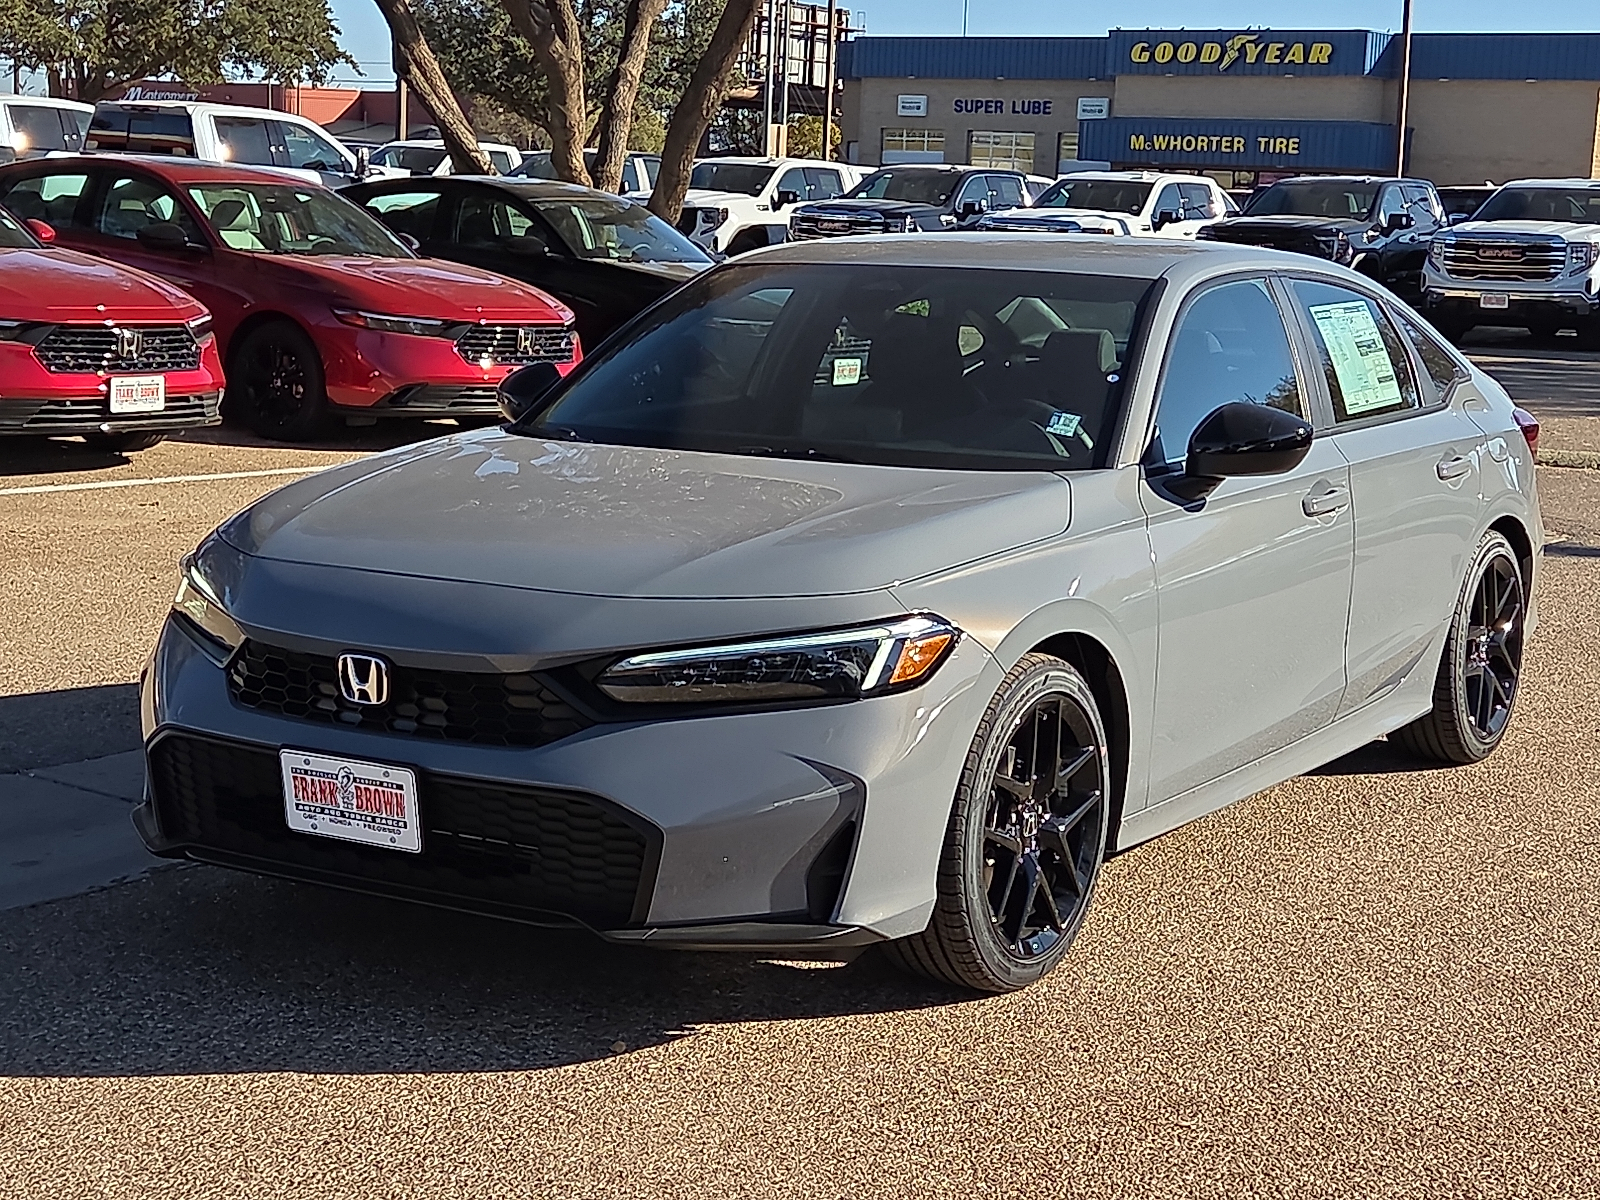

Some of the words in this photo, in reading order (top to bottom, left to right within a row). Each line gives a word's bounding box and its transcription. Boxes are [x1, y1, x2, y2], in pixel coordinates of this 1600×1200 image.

[1130, 41, 1333, 65] GOODYEAR
[953, 98, 1004, 114] SUPER
[1011, 100, 1053, 115] LUBE
[1130, 134, 1246, 153] McWHORTER
[1256, 136, 1300, 155] TIRE
[1479, 248, 1522, 257] GMC
[291, 775, 340, 808] FRANK
[354, 785, 406, 819] BROWN
